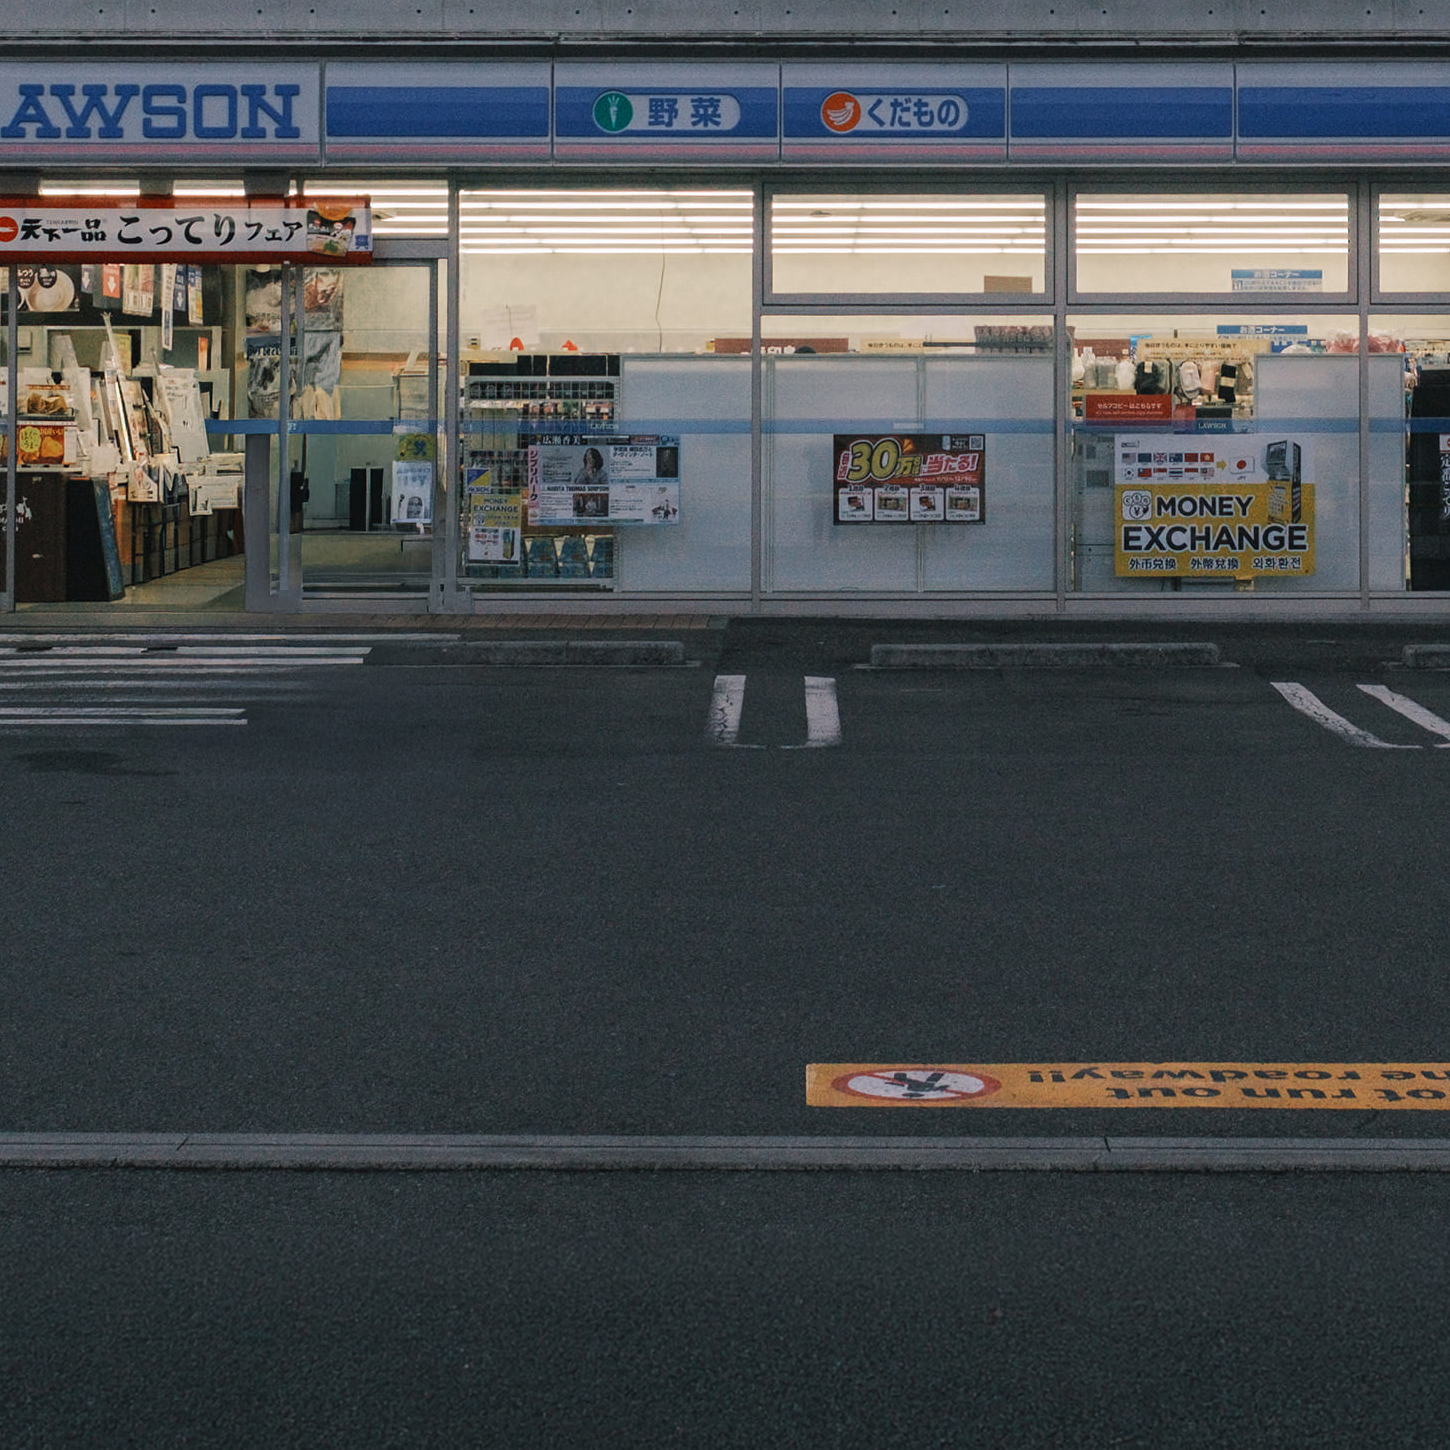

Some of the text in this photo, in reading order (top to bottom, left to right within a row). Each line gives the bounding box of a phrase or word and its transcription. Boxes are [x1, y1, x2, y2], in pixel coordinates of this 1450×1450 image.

[647, 97, 722, 128] 野菜
[867, 98, 961, 127] くだもの
[20, 218, 107, 242] 天下一品
[473, 505, 518, 513] EXCHANGE
[1156, 496, 1254, 516] MONEY
[1123, 525, 1307, 550] EXCHANGE
[1252, 557, 1302, 570] 외화환전
[1028, 1066, 1361, 1084] roadway!!
[1105, 1086, 1221, 1100] out
[1248, 1087, 1357, 1100] run
